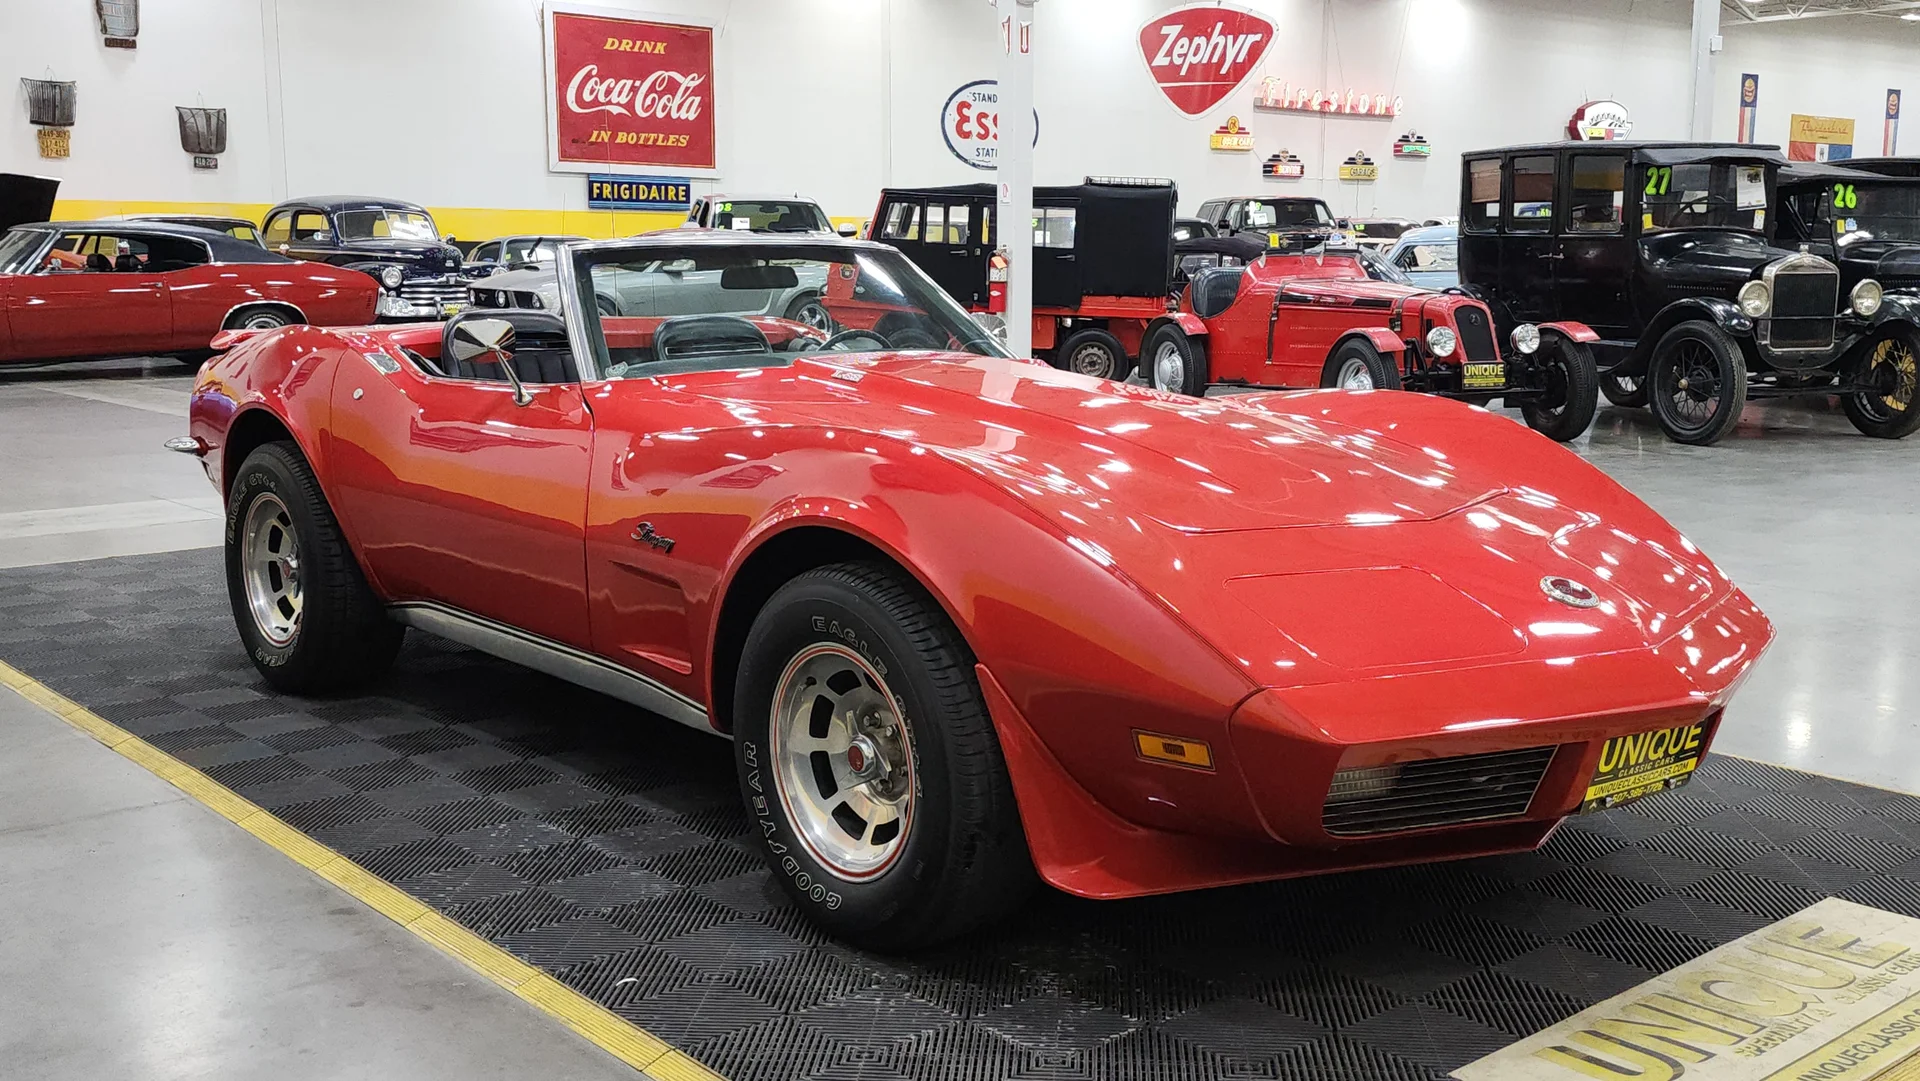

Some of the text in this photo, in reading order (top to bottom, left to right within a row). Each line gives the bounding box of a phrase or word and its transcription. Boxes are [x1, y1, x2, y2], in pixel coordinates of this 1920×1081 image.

[604, 38, 667, 54] DRINK
[1151, 22, 1262, 76] Zephyr
[566, 64, 706, 121] Coca-Cola
[972, 92, 998, 103] STAND
[589, 130, 689, 147] IN BOTTLES
[976, 147, 998, 157] STATI
[592, 183, 687, 201] FRIGIDAIRE
[1645, 167, 1671, 195] 27
[1834, 183, 1857, 209] 26
[1463, 364, 1504, 376] UNIQUE
[812, 615, 889, 676] EAGLE
[1598, 724, 1702, 773] UNIQUE
[1593, 762, 1689, 796] UNIQUECLASSICCARS.COM
[1618, 756, 1675, 778] CLASSIC CARS
[743, 740, 842, 911] GOODYEAR
[1533, 924, 1911, 1081] UNIQUE
[1796, 1008, 1920, 1081] NIQUECLASSIC
